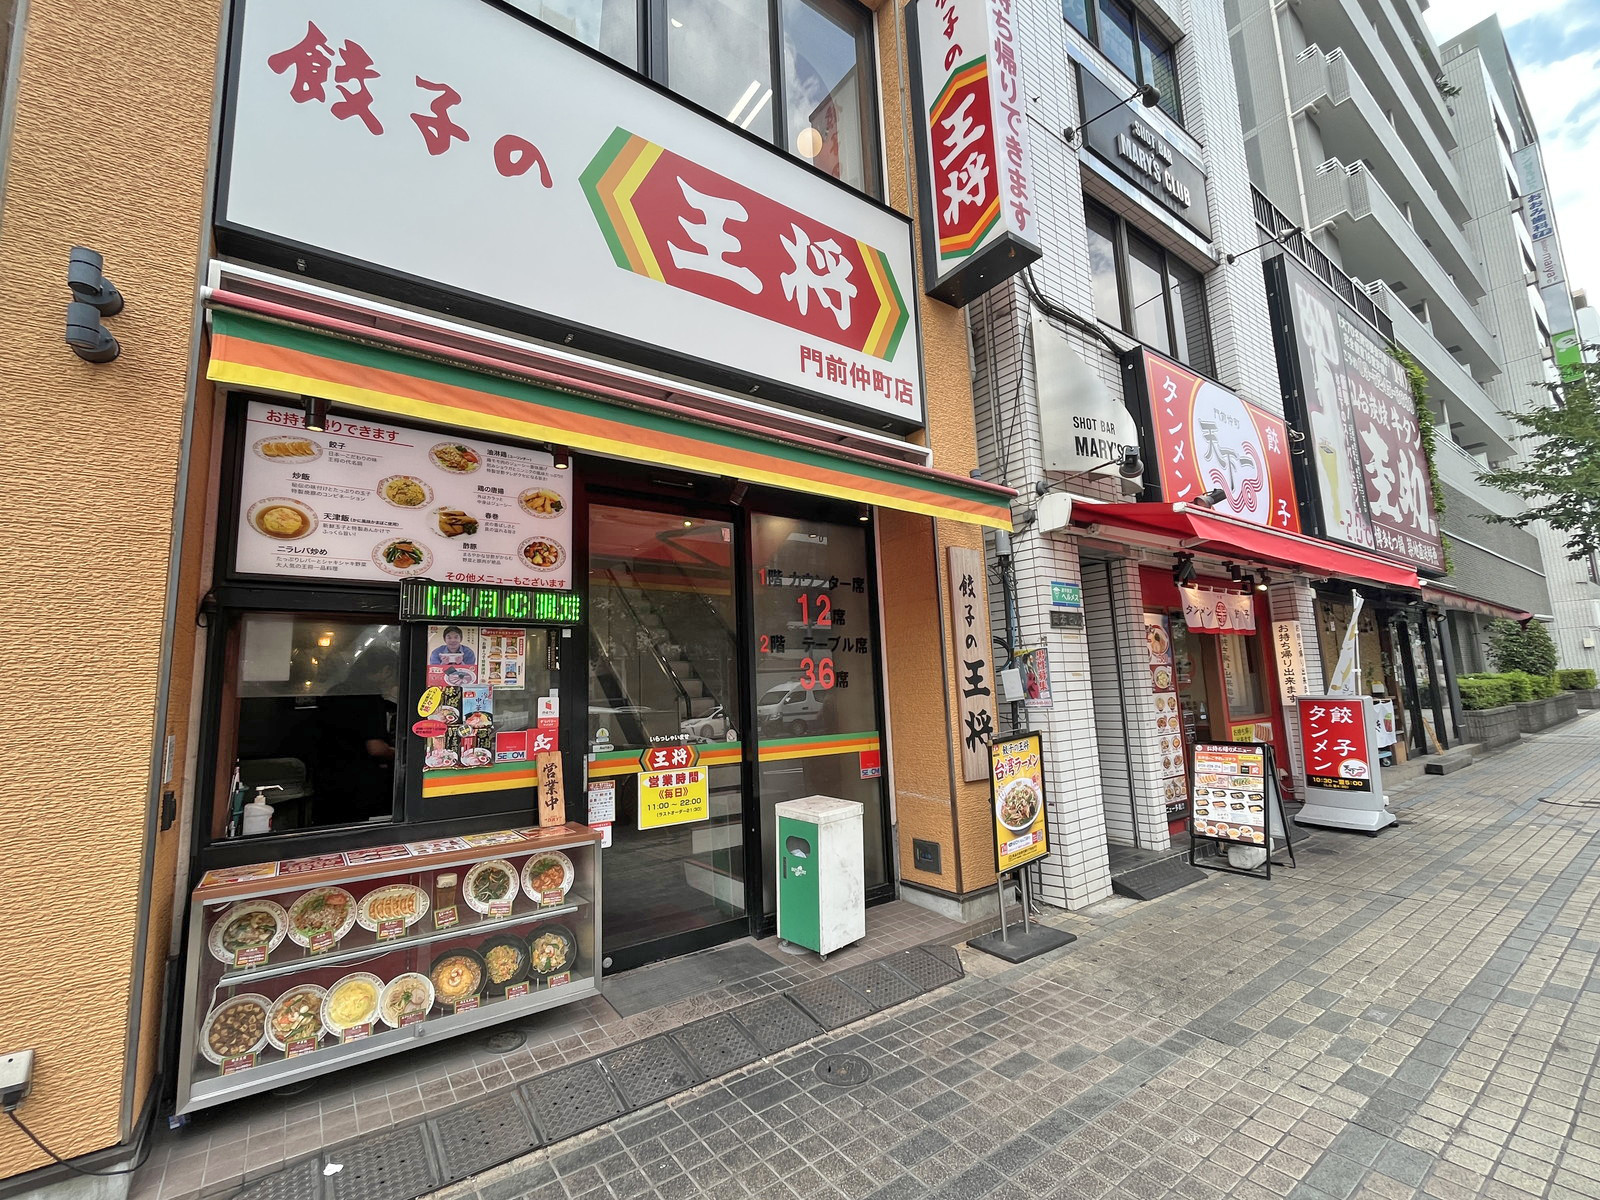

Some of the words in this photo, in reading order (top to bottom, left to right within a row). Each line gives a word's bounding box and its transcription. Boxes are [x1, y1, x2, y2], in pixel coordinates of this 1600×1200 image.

[935, 0, 963, 71] 子の
[1133, 120, 1156, 150] SHOT
[1157, 140, 1173, 166] BAR
[940, 92, 990, 226] 王将
[1117, 133, 1162, 184] MARY'S
[1164, 170, 1191, 208] CLUB
[667, 175, 858, 331] 王将
[800, 346, 914, 407] 門前仲町店
[267, 409, 399, 441] お持りできます
[1073, 416, 1097, 430] SHOT
[1100, 420, 1116, 435] BAR
[1163, 375, 1192, 498] タンメン
[328, 441, 346, 450] 餃子
[1198, 417, 1254, 493] 天下一
[292, 471, 310, 481] 炒飯
[1265, 426, 1291, 527] 餃子
[323, 513, 349, 523] 天津飯
[277, 545, 328, 556] ニラレバ炒め
[445, 572, 566, 588] その他メニューもございます
[758, 568, 783, 587] 1階
[788, 571, 865, 593] カウンター席
[760, 635, 786, 653] 2階
[802, 636, 868, 654] テーブル席
[958, 573, 994, 754] 餃子の王将
[1278, 624, 1298, 704] お持ち帰り出来ます
[649, 734, 690, 743] いらっしゃいませ
[1309, 705, 1332, 771] タンメン
[1329, 706, 1357, 757] 餃子
[497, 751, 525, 760] SECOM
[653, 748, 688, 768] 王将
[1002, 740, 1030, 756] 餃子の王将
[649, 771, 699, 788] 営業時間
[861, 768, 880, 777] SECOM
[994, 754, 1040, 781] 台湾ラーメン
[543, 763, 559, 810] 営業中
[647, 802, 669, 811] 11:00
[680, 798, 701, 807] 22:00
